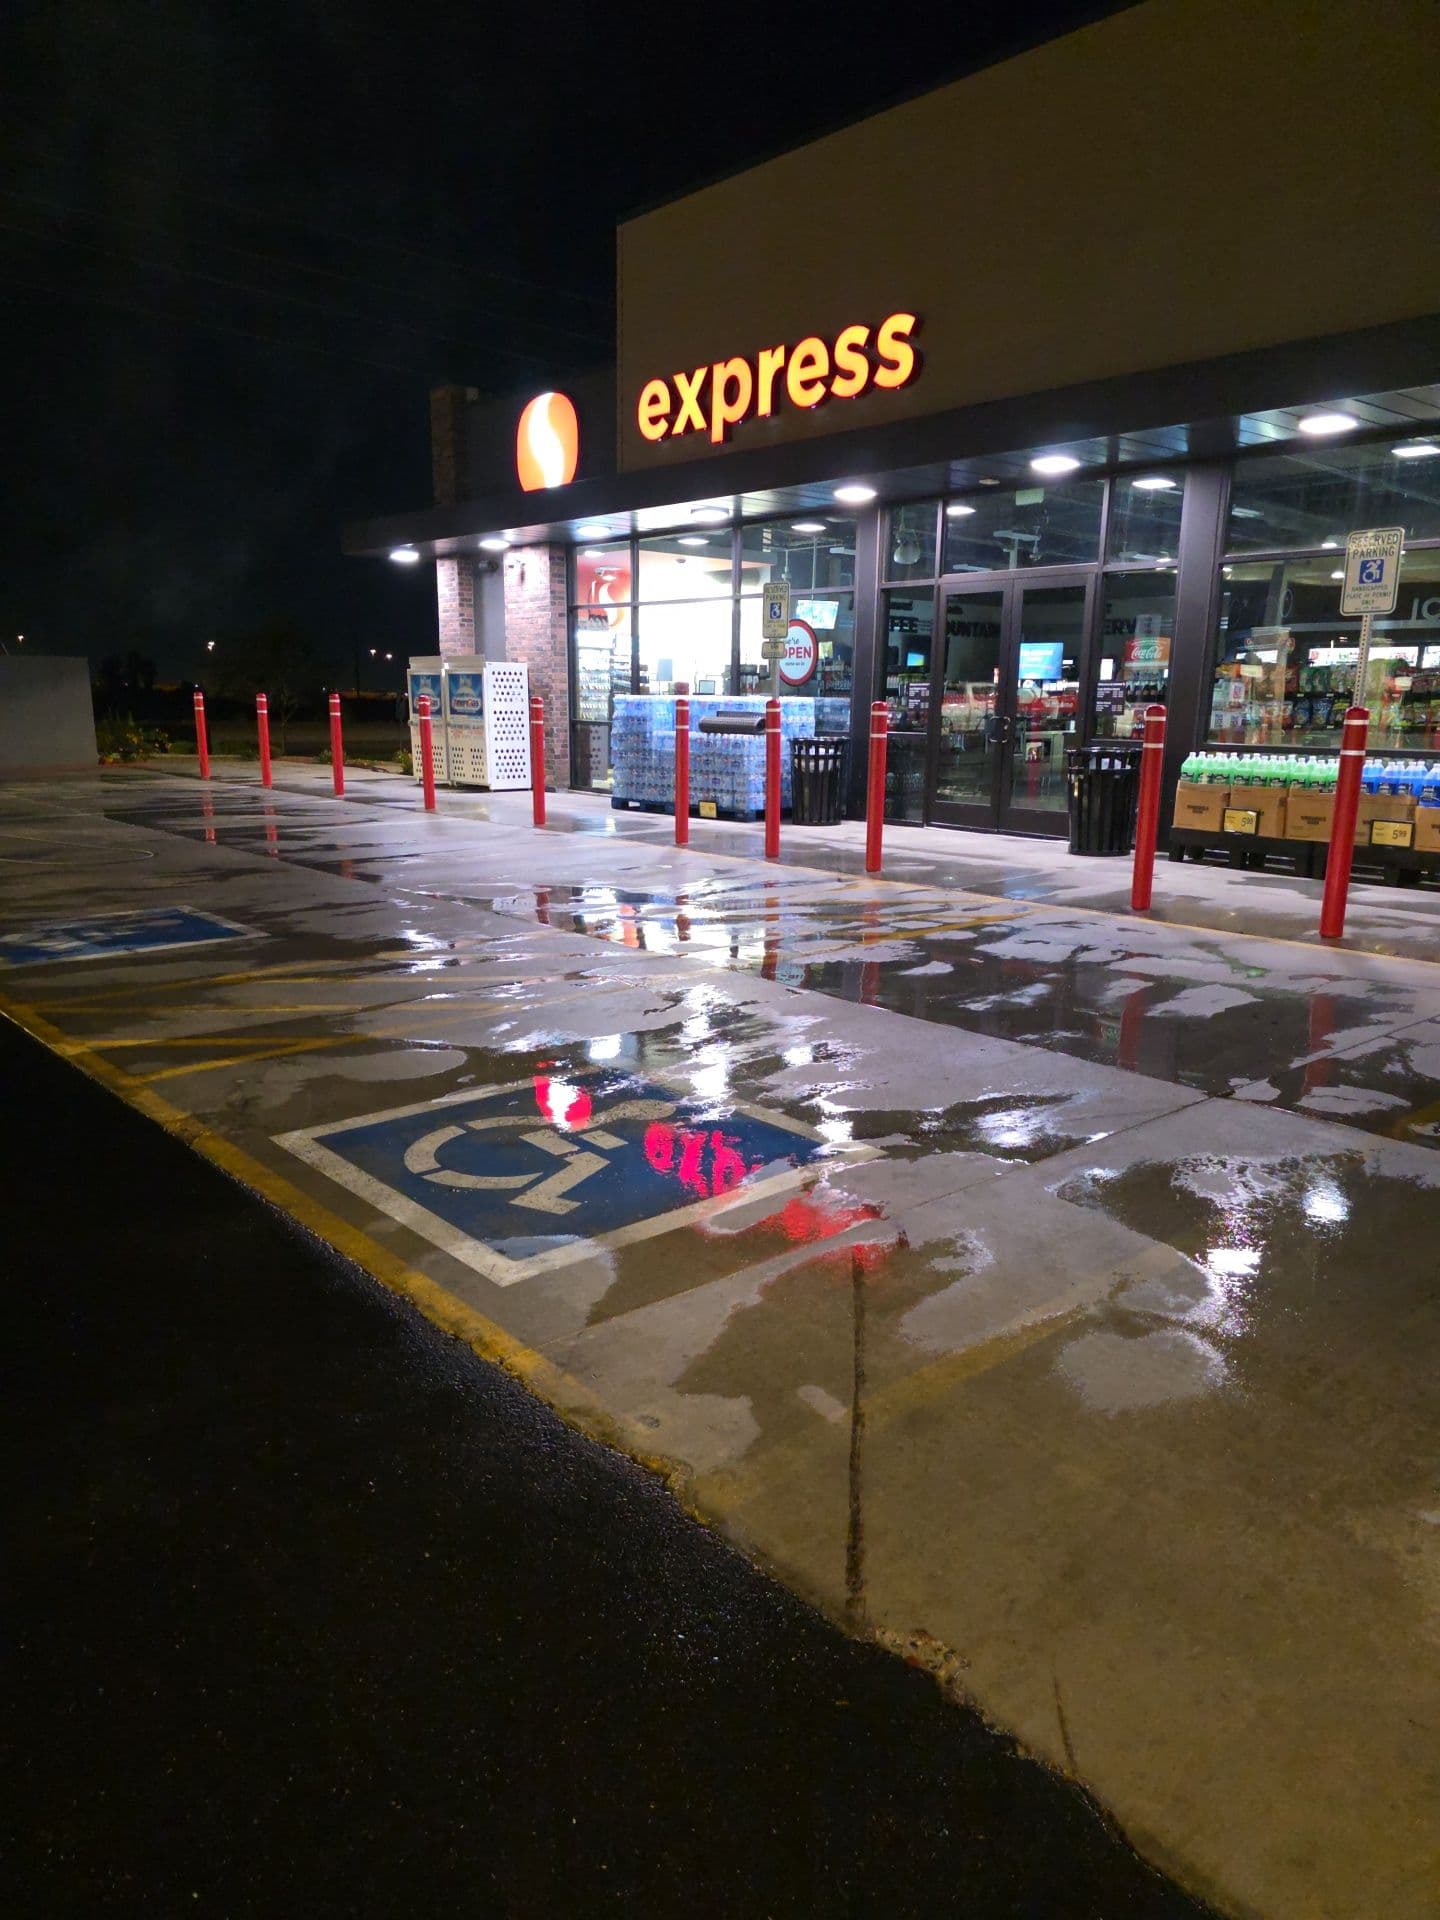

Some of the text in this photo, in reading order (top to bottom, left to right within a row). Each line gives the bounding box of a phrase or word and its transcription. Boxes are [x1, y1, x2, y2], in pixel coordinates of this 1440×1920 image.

[637, 311, 919, 444] express
[1351, 533, 1399, 546] RESERVED
[1353, 546, 1395, 559] PARKING
